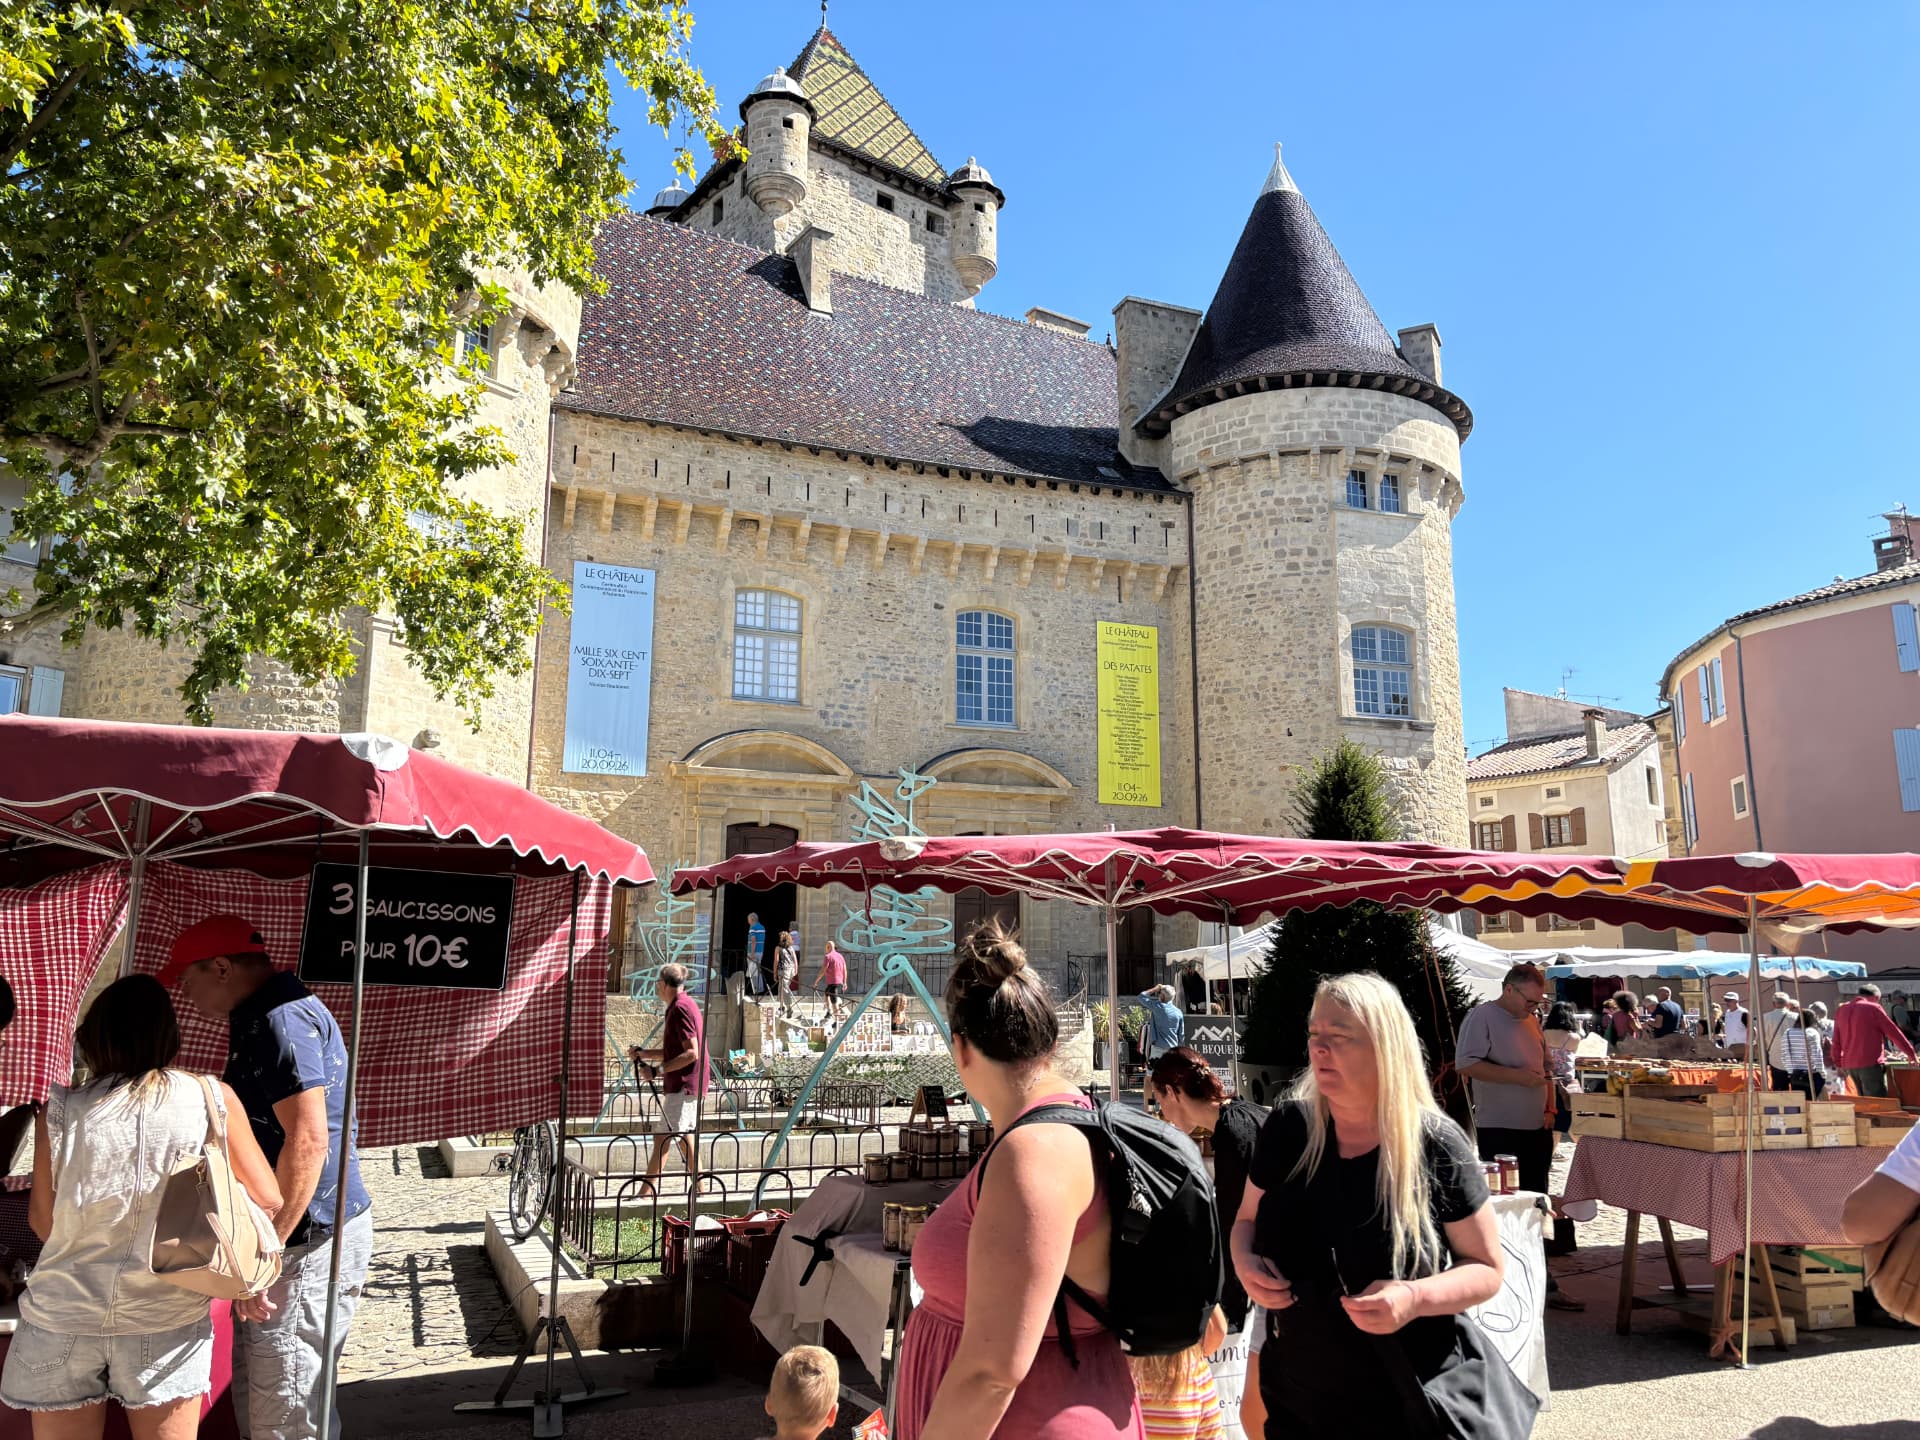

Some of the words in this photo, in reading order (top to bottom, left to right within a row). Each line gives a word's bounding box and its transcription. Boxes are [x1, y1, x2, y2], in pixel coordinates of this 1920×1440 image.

[585, 568, 595, 578] LE
[597, 569, 644, 584] CHÂTEAU
[1105, 626, 1113, 636] LE
[1114, 627, 1150, 639] CHÂTEAU
[573, 645, 602, 657] MILLE
[604, 648, 618, 658] SIX
[622, 650, 648, 661] CENT
[581, 657, 639, 671] SOIXANTE-
[1103, 660, 1118, 671] DES
[1119, 662, 1152, 674] PATATES
[588, 667, 632, 680] DIX-SEPT
[328, 882, 354, 915] 3
[364, 898, 496, 924] SAUCISSONS
[340, 940, 396, 959] POUR
[403, 934, 469, 969] 10€
